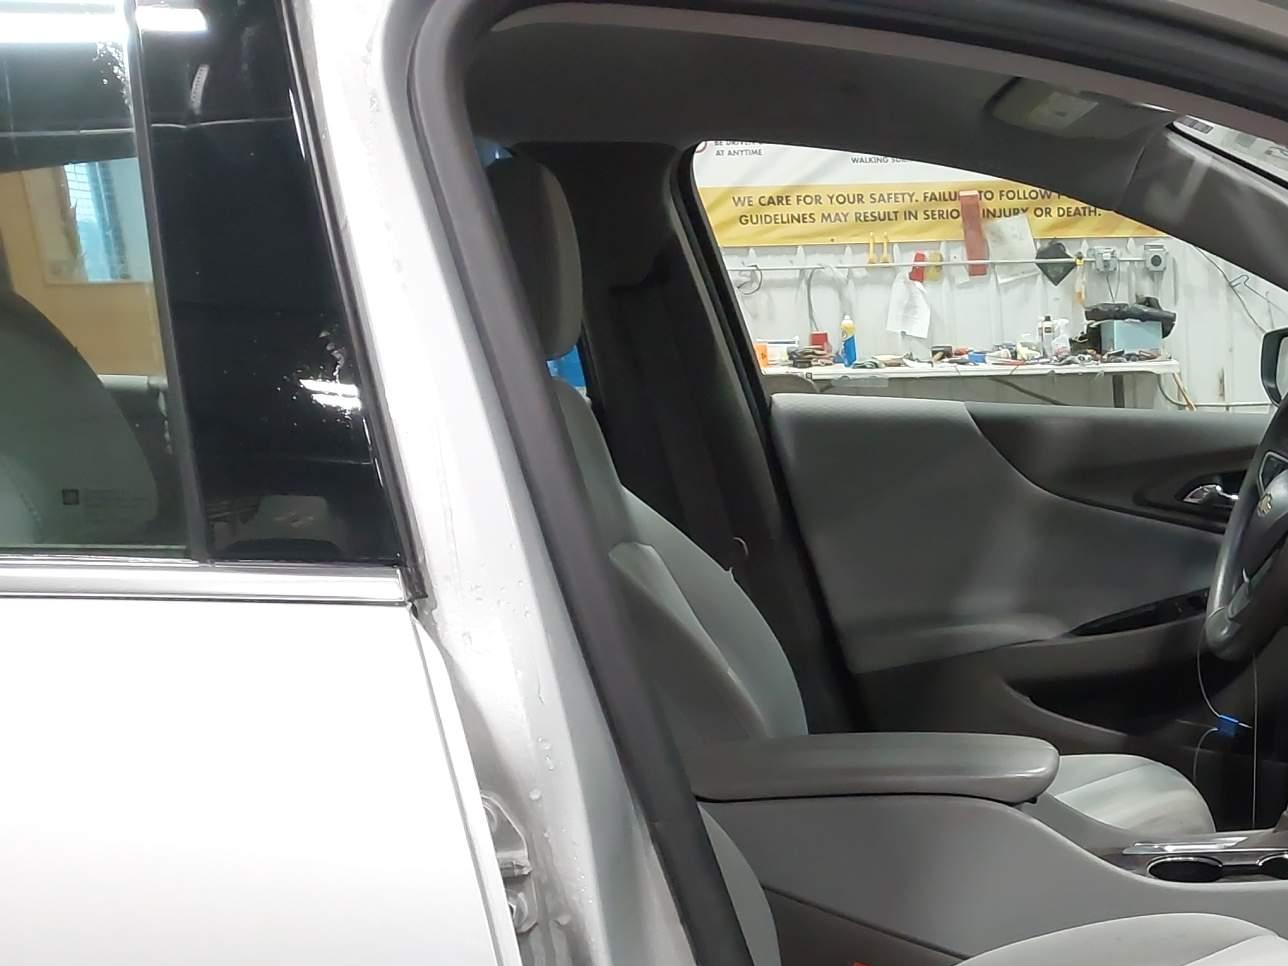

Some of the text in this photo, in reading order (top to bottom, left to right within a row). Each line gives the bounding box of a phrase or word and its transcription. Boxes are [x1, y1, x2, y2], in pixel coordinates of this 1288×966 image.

[727, 148, 763, 156] ANYTIME
[732, 195, 753, 207] WE
[758, 195, 792, 206] CARE
[796, 194, 823, 205] FOR
[827, 193, 865, 205] YOUR
[869, 191, 919, 204] SAFETY.
[978, 189, 995, 201] TO
[999, 189, 1052, 201] FOLLOW
[738, 212, 816, 225] GUIDELINES
[821, 211, 849, 224] MAY
[854, 210, 899, 223] RESULT
[903, 209, 918, 221] IN
[923, 208, 960, 220] SERIO
[1033, 206, 1052, 218] OR
[1057, 206, 1102, 218] DEATH.
